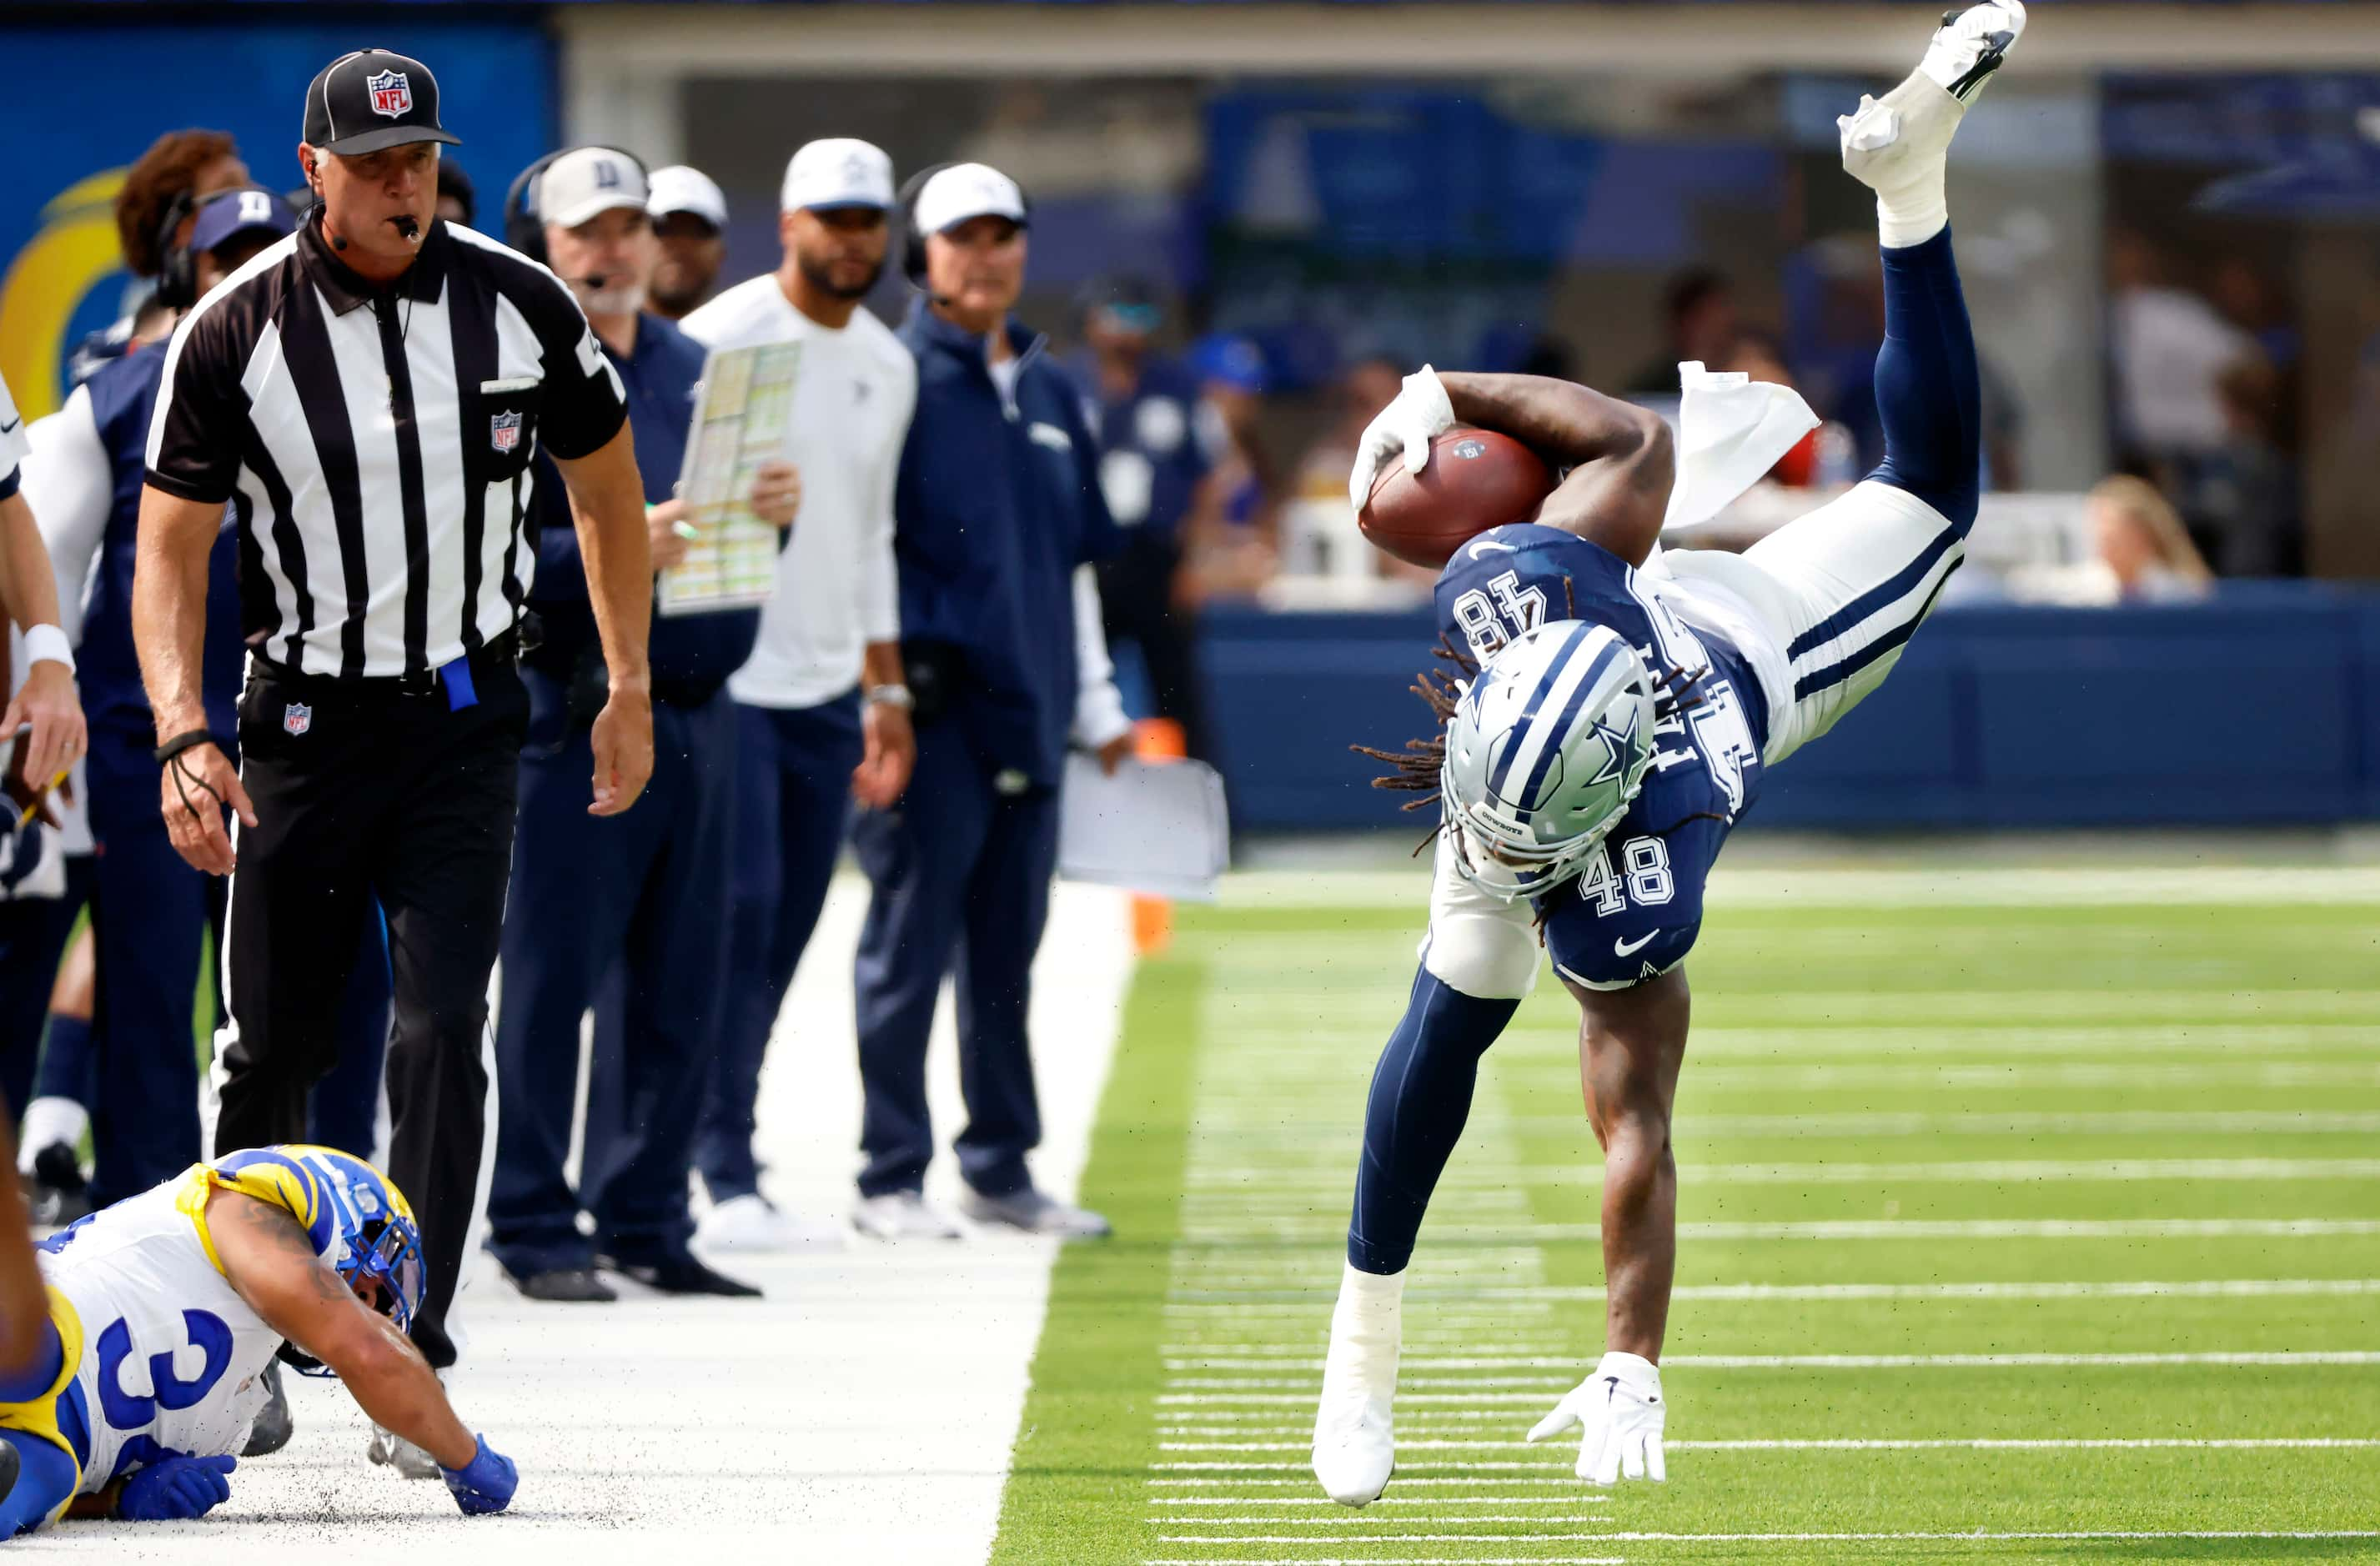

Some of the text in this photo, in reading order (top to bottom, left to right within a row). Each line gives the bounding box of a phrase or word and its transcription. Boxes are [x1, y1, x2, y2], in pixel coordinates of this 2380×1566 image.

[375, 90, 409, 111] NFL
[494, 429, 519, 447] NFL
[1454, 570, 1547, 672] 48
[287, 715, 308, 730] NFL
[1577, 836, 1675, 918] 48
